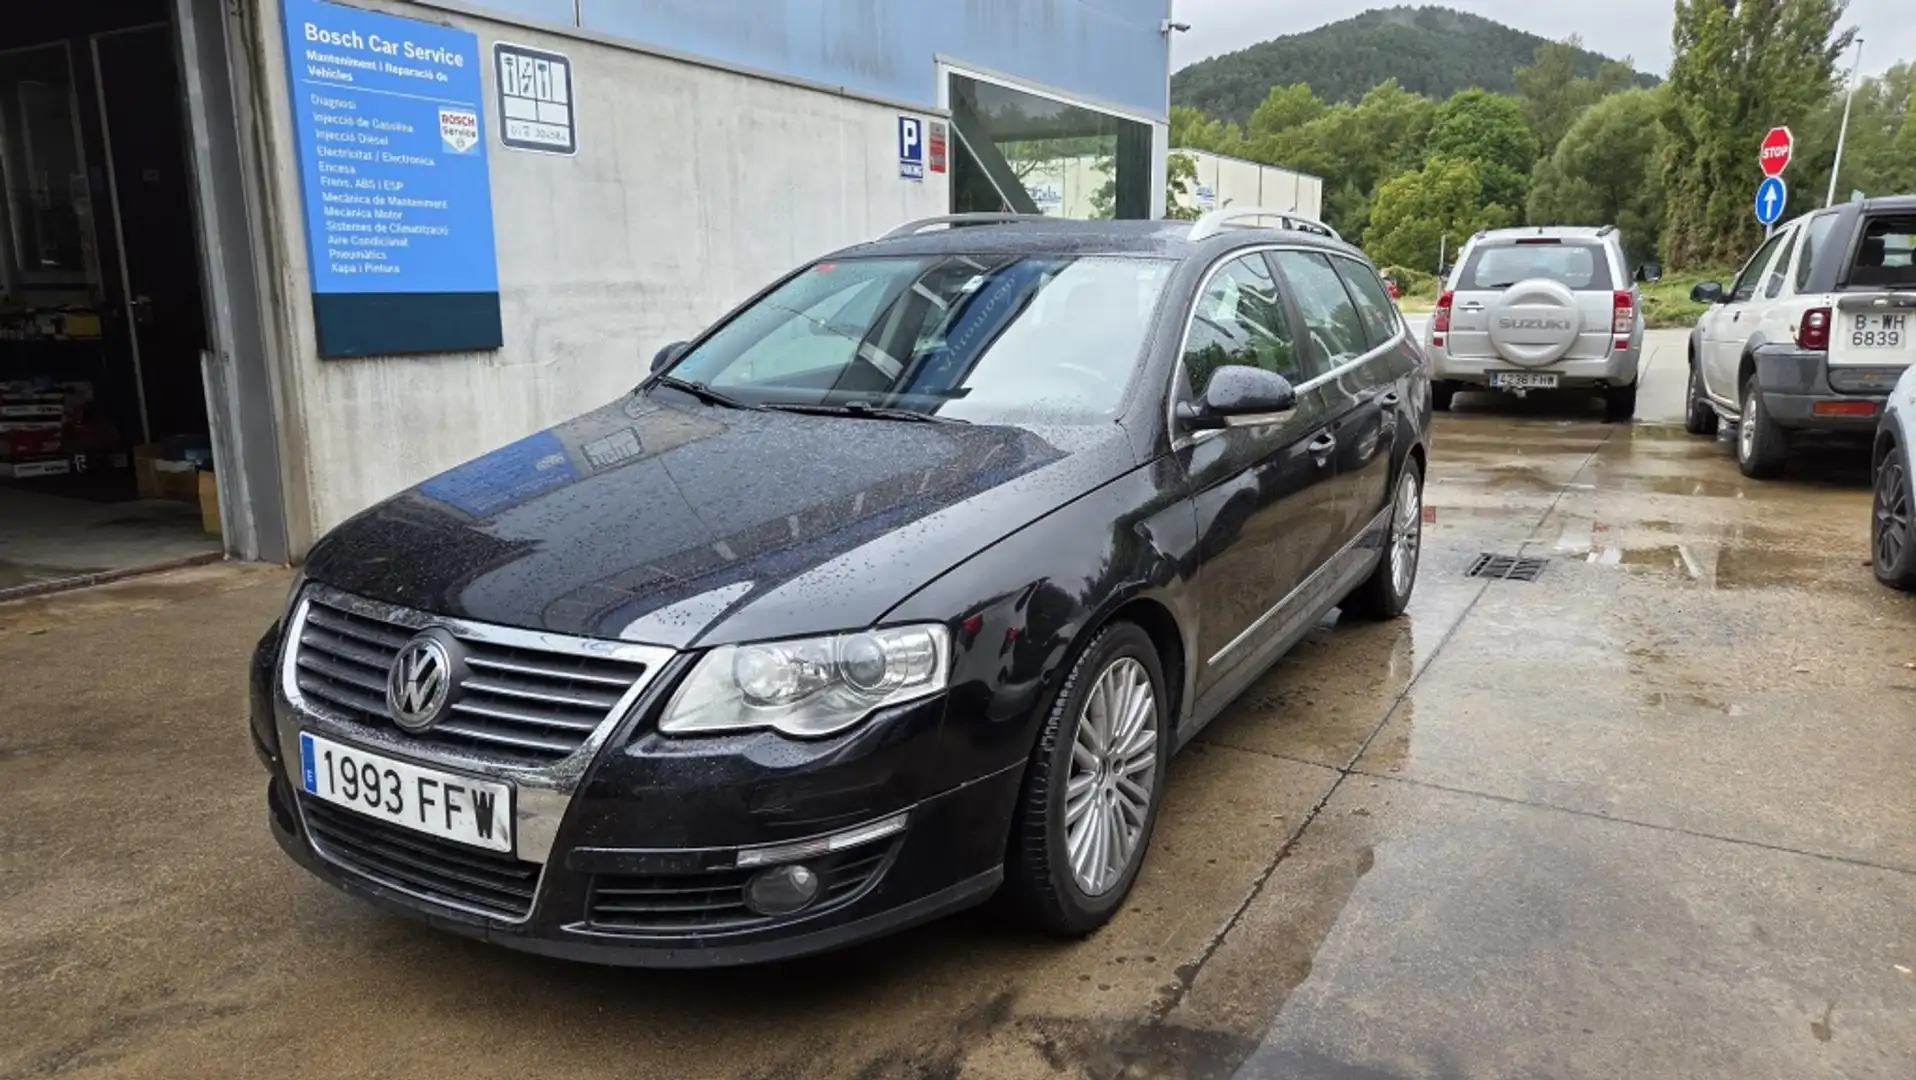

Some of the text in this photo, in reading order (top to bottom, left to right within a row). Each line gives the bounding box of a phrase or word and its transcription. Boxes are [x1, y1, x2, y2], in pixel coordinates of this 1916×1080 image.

[304, 22, 464, 67] Bosch Car Service
[305, 50, 377, 70] Manteniment
[379, 60, 383, 72] i
[307, 64, 353, 81] Vehicles
[357, 116, 370, 128] de
[441, 114, 475, 126] BOSCH
[442, 125, 477, 138] Service
[904, 120, 918, 157] P
[1763, 145, 1788, 159] STOP
[318, 161, 356, 174] Encesa
[355, 178, 376, 190] ABS
[383, 180, 404, 191] ESP
[372, 195, 386, 206] de
[374, 209, 403, 221] Motor
[326, 220, 373, 233] Sistemes
[374, 223, 387, 234] de
[328, 235, 349, 246] Aire
[331, 263, 357, 275] Xapa
[364, 263, 400, 274] Pintura
[1499, 318, 1571, 330] SUZUKI
[1852, 331, 1899, 346] 6839
[324, 750, 495, 840] 1993 FFW
